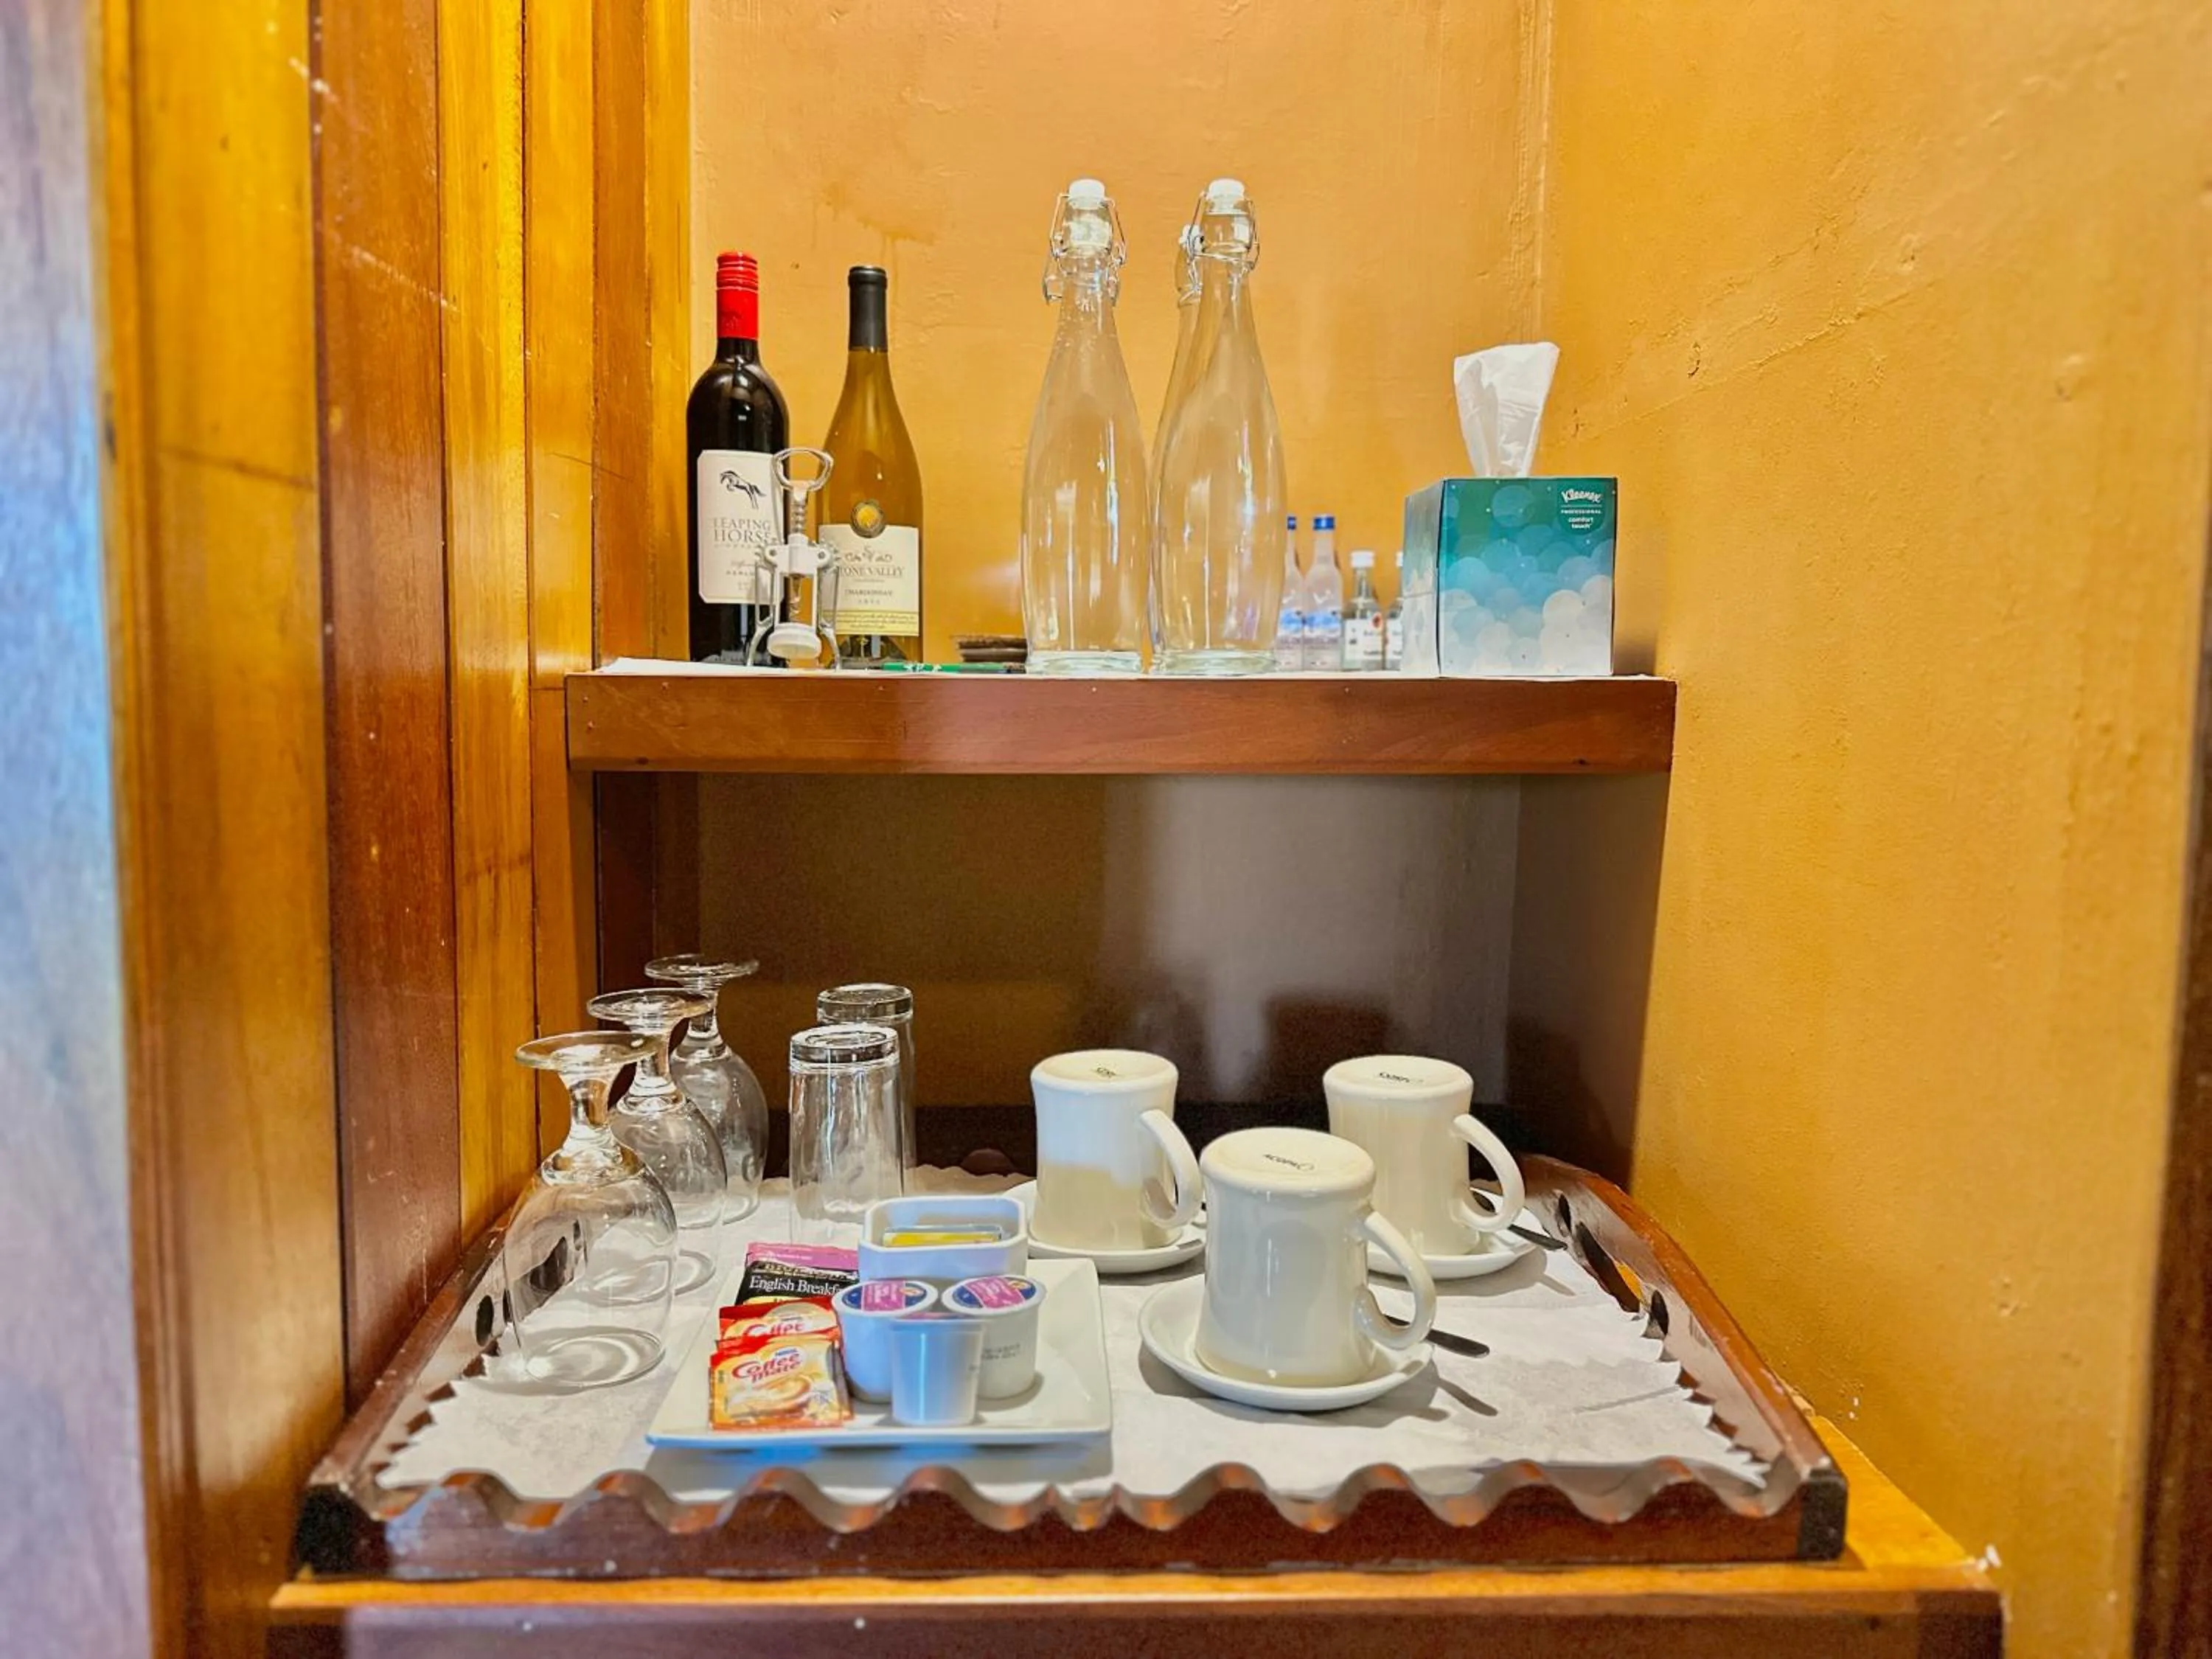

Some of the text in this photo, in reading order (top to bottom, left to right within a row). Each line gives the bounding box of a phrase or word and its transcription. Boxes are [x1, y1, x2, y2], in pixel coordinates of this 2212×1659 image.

[713, 518, 771, 530] LEAPING
[867, 566, 905, 577] VALLEY
[749, 1275, 843, 1295] English Breakf
[731, 1352, 801, 1379] Coffee
[751, 1360, 802, 1382] mate
